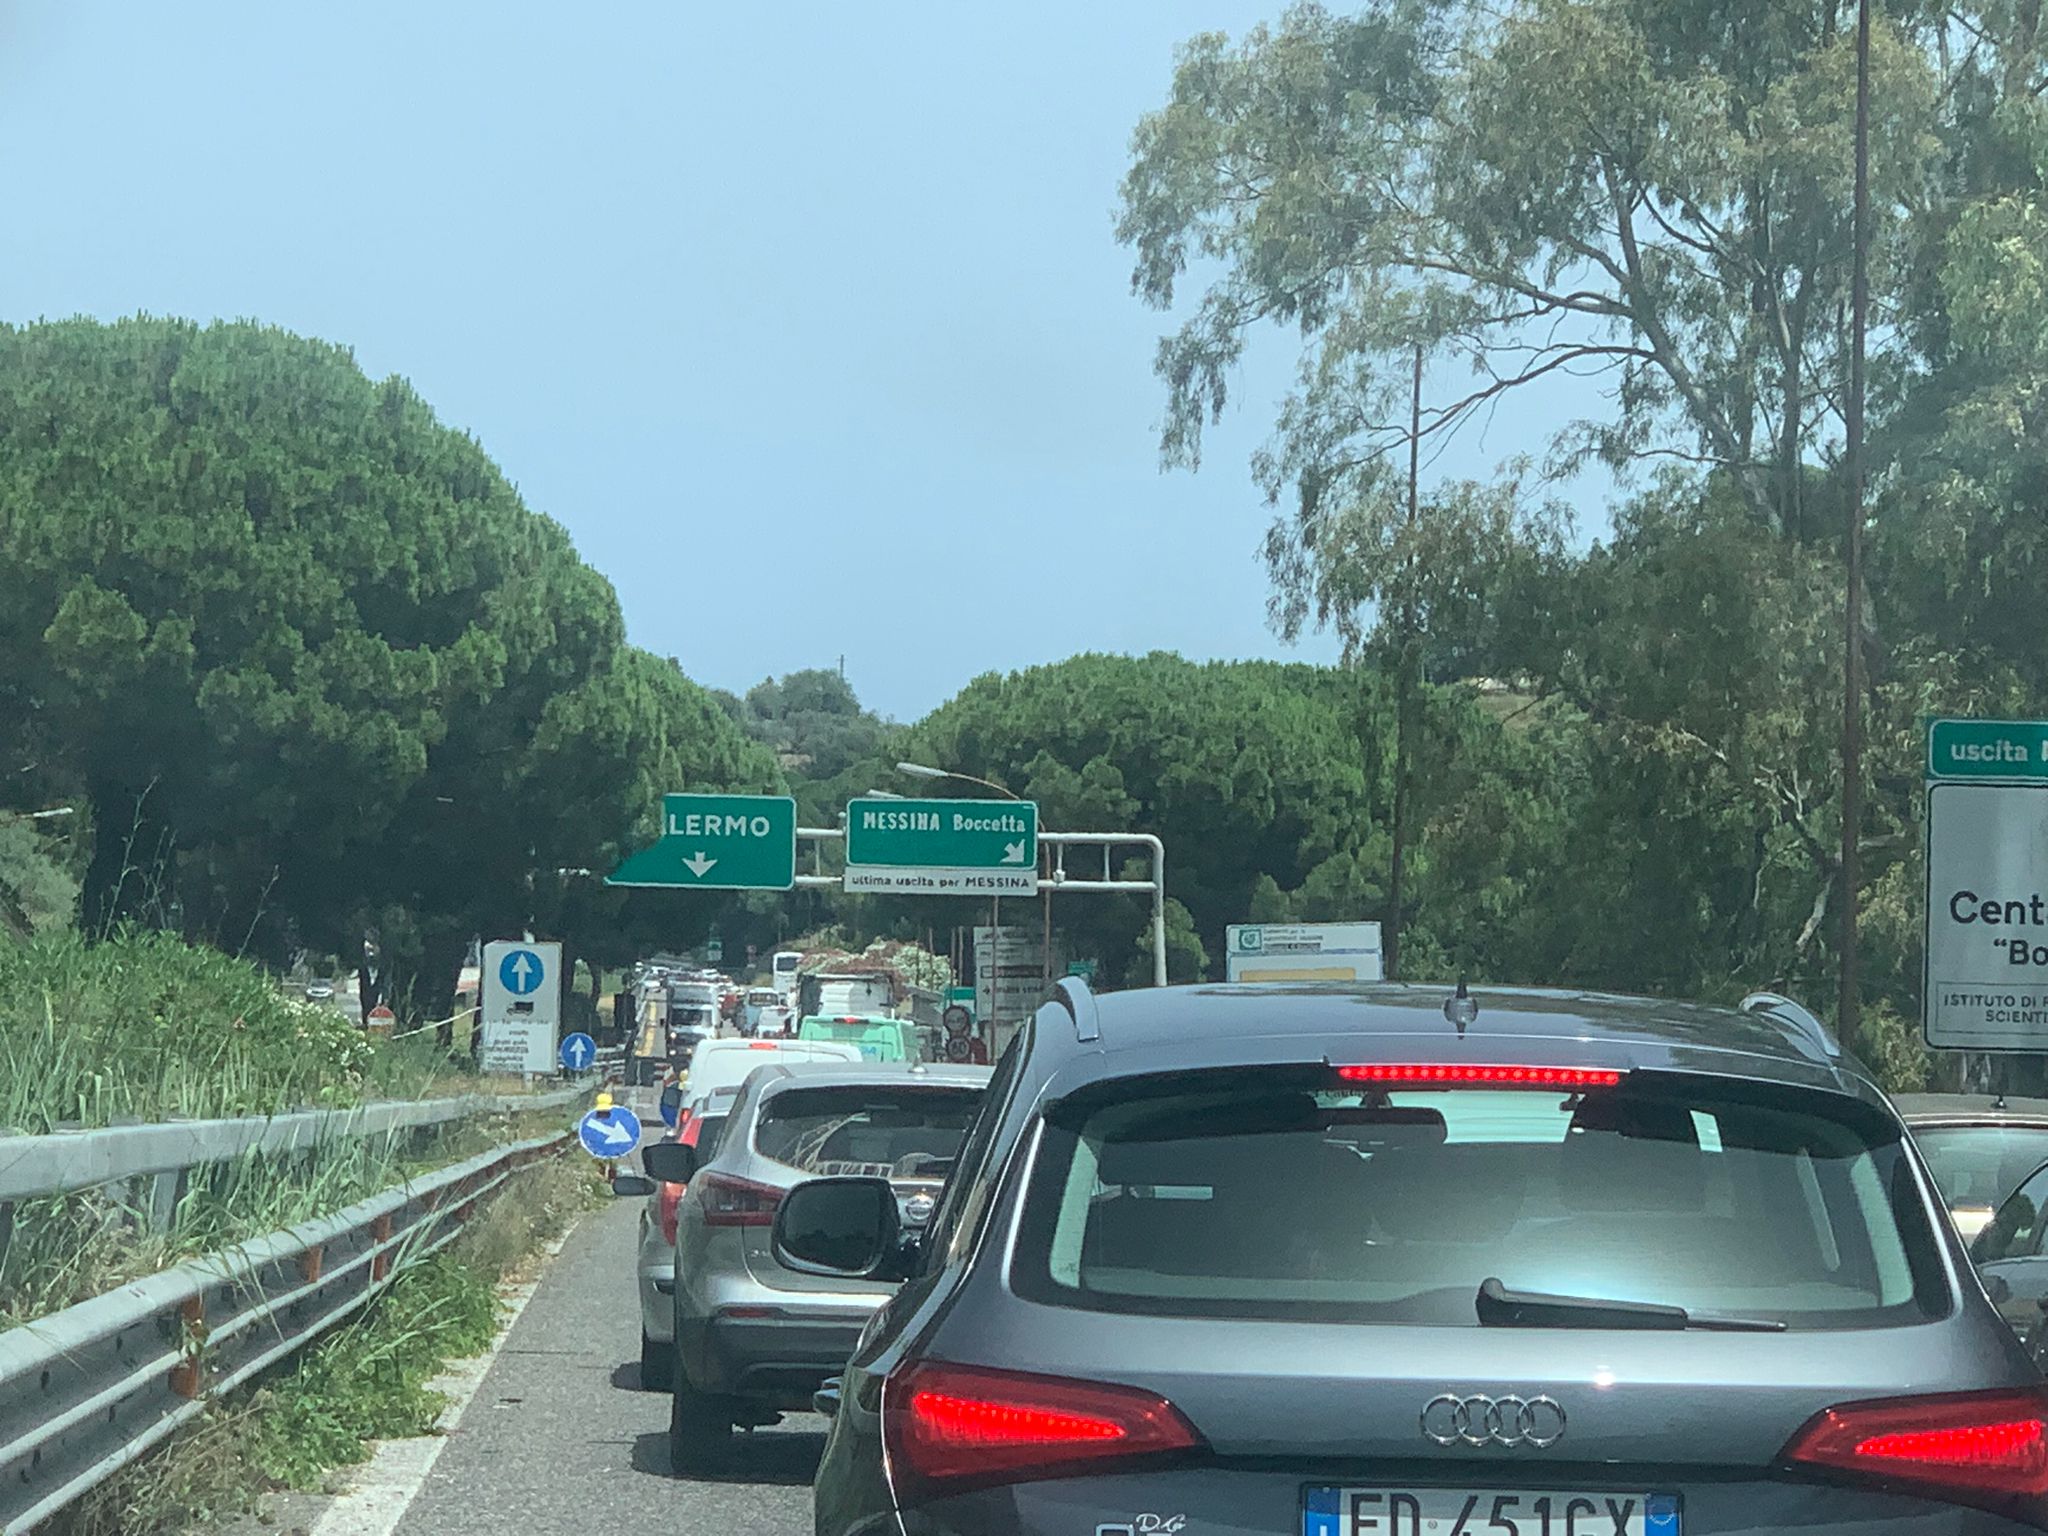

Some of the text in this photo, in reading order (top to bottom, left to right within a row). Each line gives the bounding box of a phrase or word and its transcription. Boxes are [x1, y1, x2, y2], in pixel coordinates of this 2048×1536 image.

[1951, 739, 2029, 762] uscita
[662, 814, 770, 837] LERMO
[863, 812, 1026, 833] MESSINA Boccetta
[852, 875, 1030, 888] ultima uscita per MESSINA
[1950, 891, 2048, 926] Cent
[1944, 994, 2016, 1008] ISTITUTO
[2020, 996, 2036, 1008] DI
